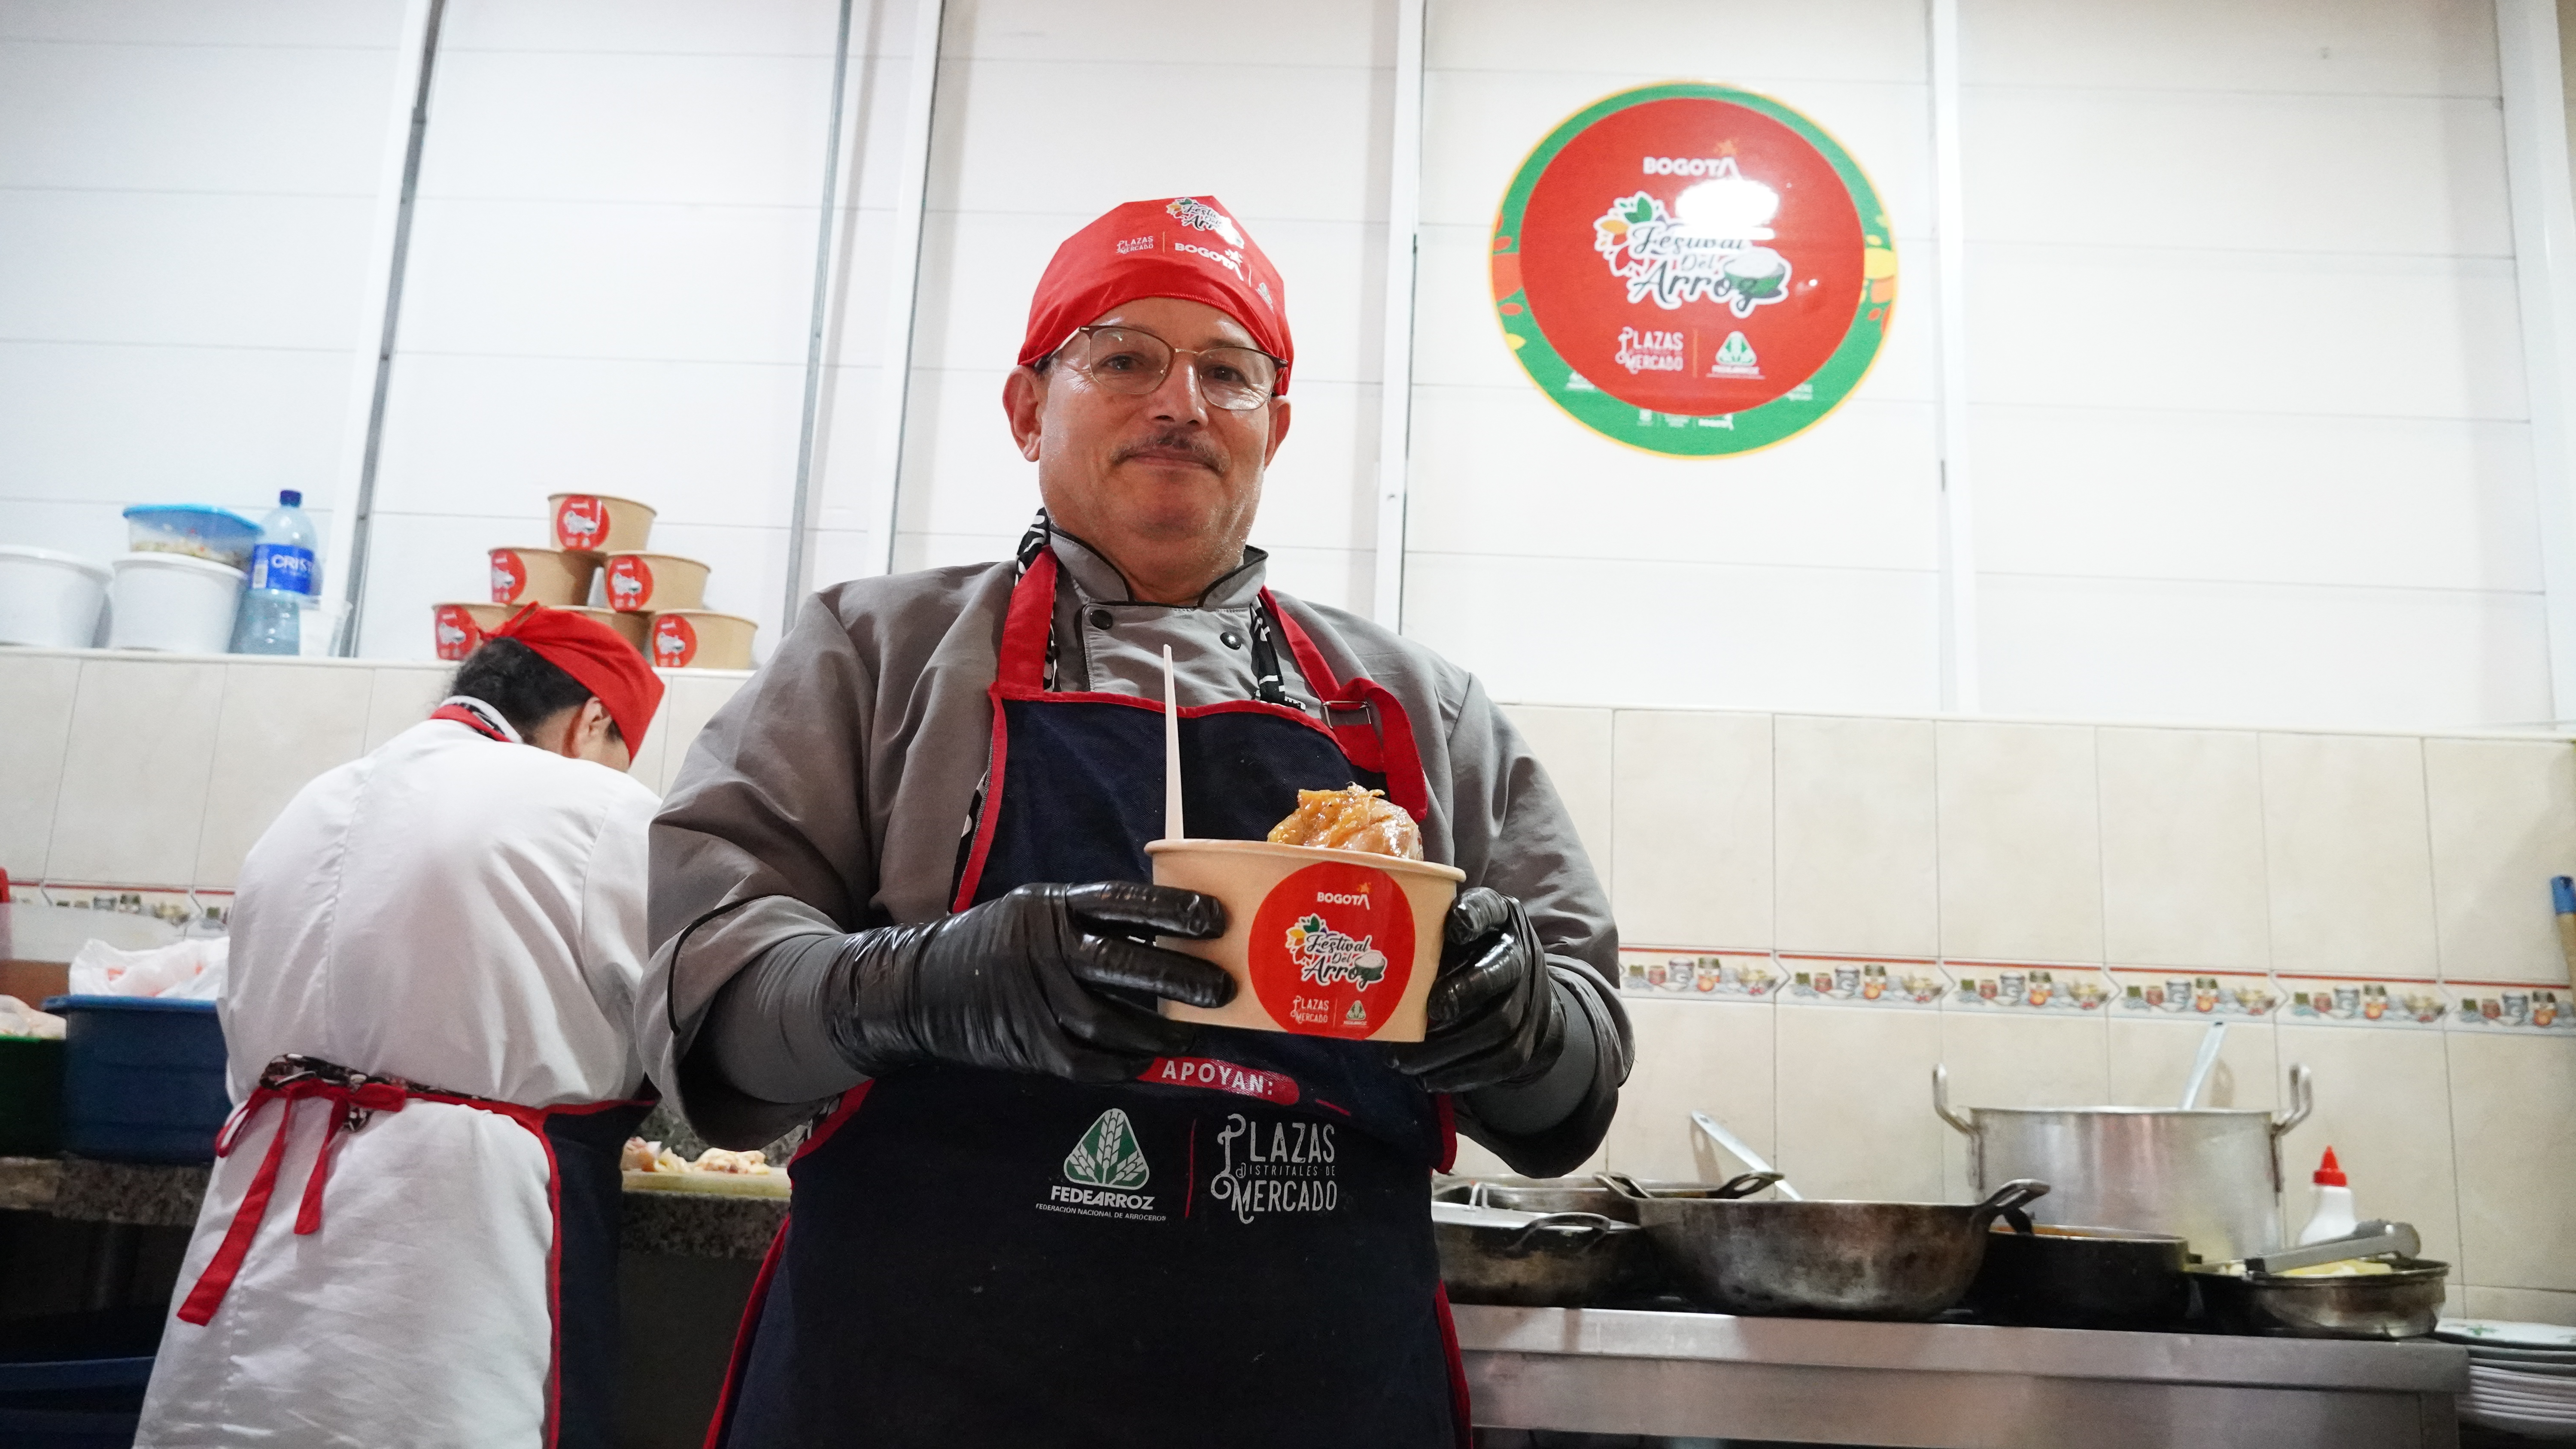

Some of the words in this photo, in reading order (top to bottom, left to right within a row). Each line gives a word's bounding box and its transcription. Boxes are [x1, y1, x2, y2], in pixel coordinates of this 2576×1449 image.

[1184, 215, 1220, 230] Arr
[1116, 244, 1154, 254] MERCADO
[1117, 236, 1154, 249] PLAZAS
[1681, 254, 1715, 271] Del
[1618, 326, 1684, 352] PLAZAS
[1615, 352, 1684, 374] MERCADO
[1306, 934, 1369, 953] Festival
[1332, 952, 1352, 964] Del
[1293, 995, 1329, 1011] PLAZAS
[1290, 1010, 1328, 1024] MERCADO
[1162, 1060, 1273, 1095] APOYAN:
[1217, 1113, 1334, 1174] PLAZAS
[1236, 1162, 1318, 1178] DISTRITALES
[1326, 1165, 1335, 1176] DE
[1051, 1185, 1155, 1210] FEDEARROZ
[1211, 1173, 1337, 1224] MERCADO
[1036, 1203, 1076, 1214] FEDERACIÓN
[1078, 1209, 1112, 1218] NACIONAL
[1125, 1213, 1166, 1222] ARROCEROS
